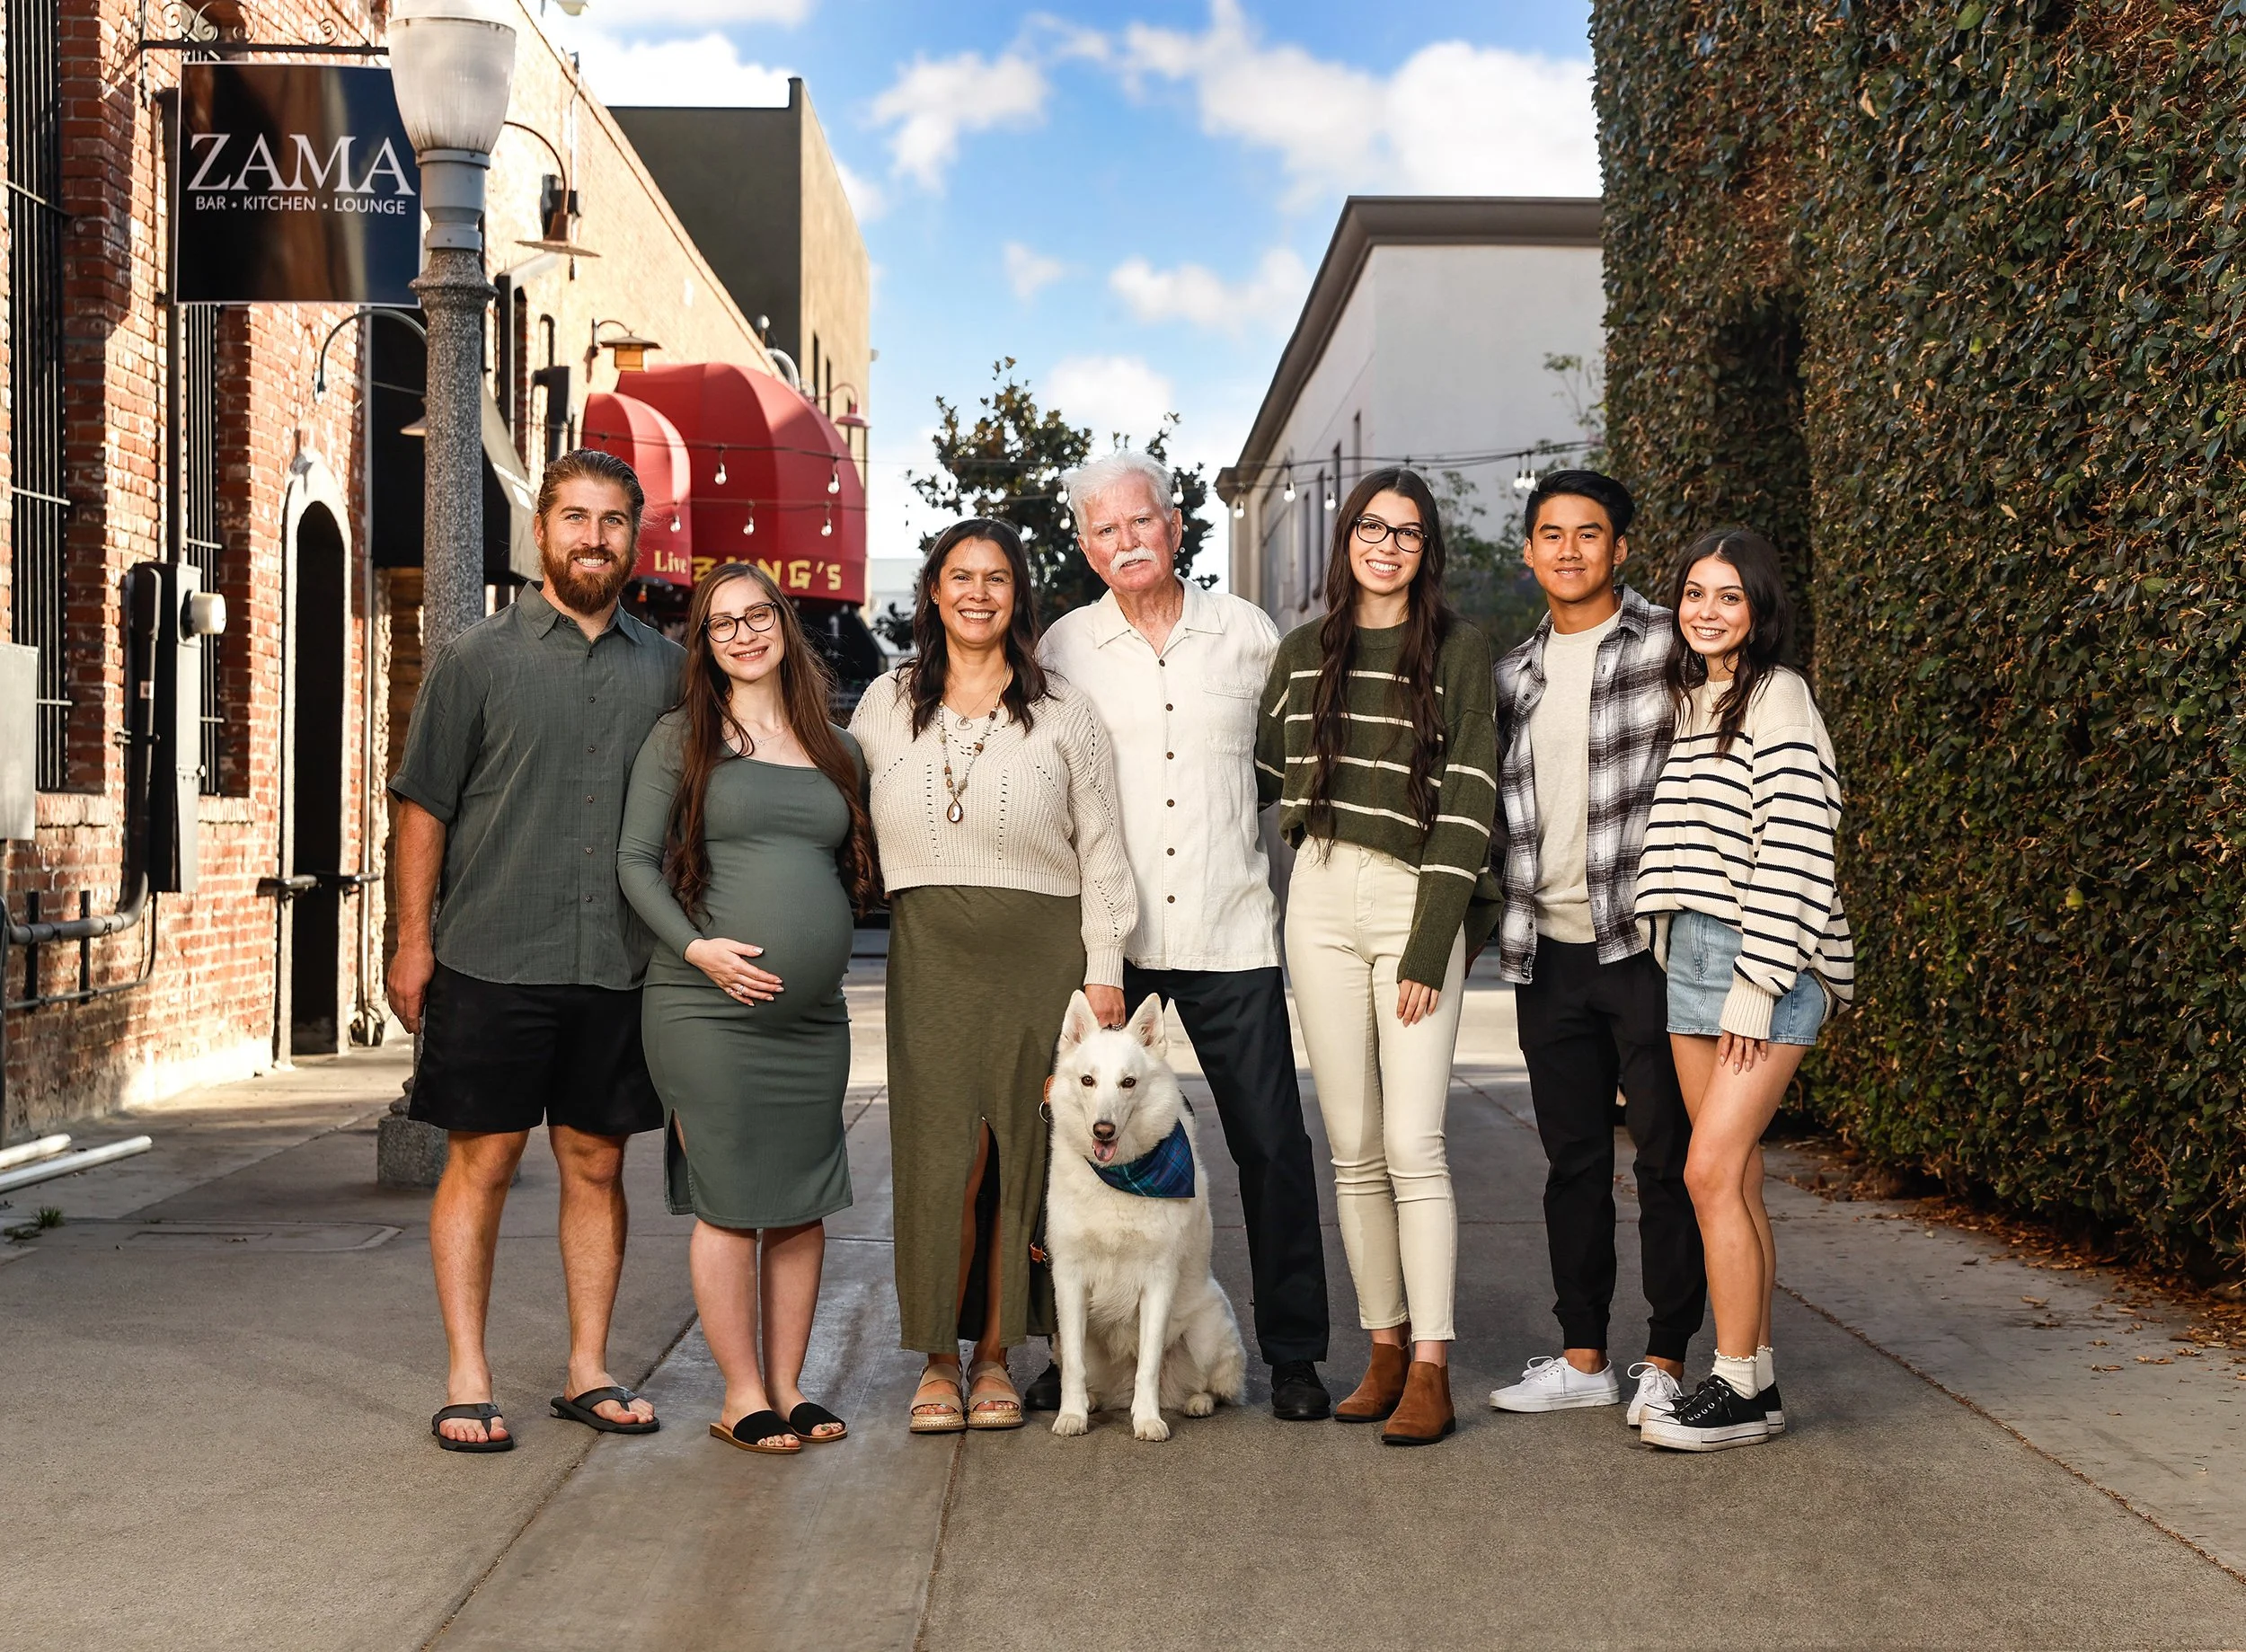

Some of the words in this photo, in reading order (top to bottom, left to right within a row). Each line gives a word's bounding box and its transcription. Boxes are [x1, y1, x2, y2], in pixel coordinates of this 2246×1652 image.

[187, 132, 416, 196] ZAMA
[195, 195, 226, 211] BAR
[243, 195, 316, 212] KITCHEN
[333, 196, 407, 216] LOUNGE
[654, 550, 687, 574] Live
[691, 556, 842, 590] ZNG'S
